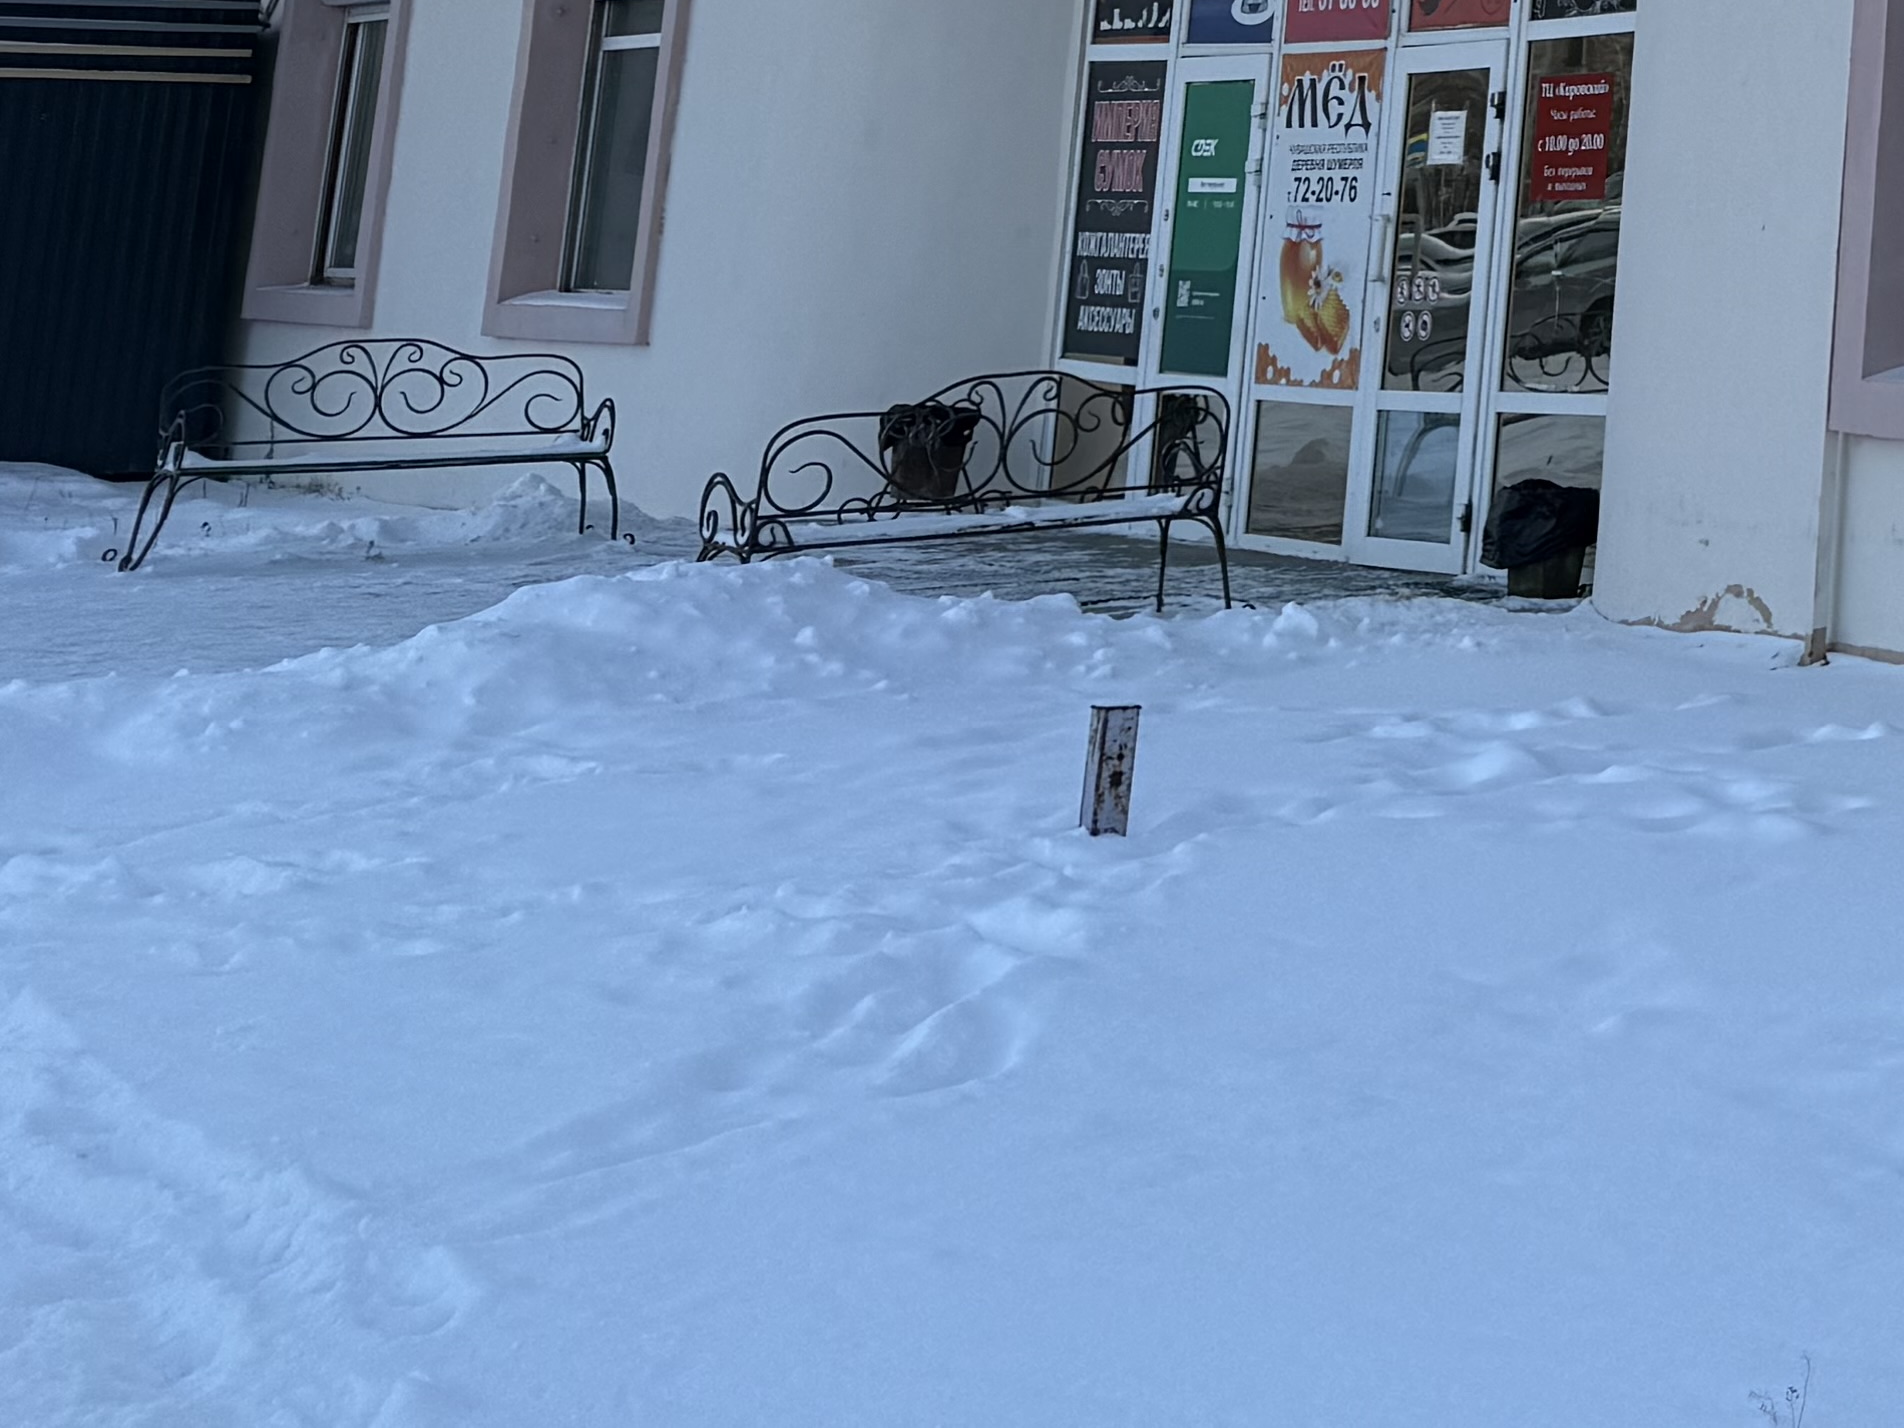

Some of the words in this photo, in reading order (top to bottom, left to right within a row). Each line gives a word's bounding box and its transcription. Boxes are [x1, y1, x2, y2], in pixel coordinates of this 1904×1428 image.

[1286, 63, 1372, 139] МЁД
[1094, 150, 1147, 192] СУМОК
[1094, 269, 1126, 295] ЗОНТЫ
